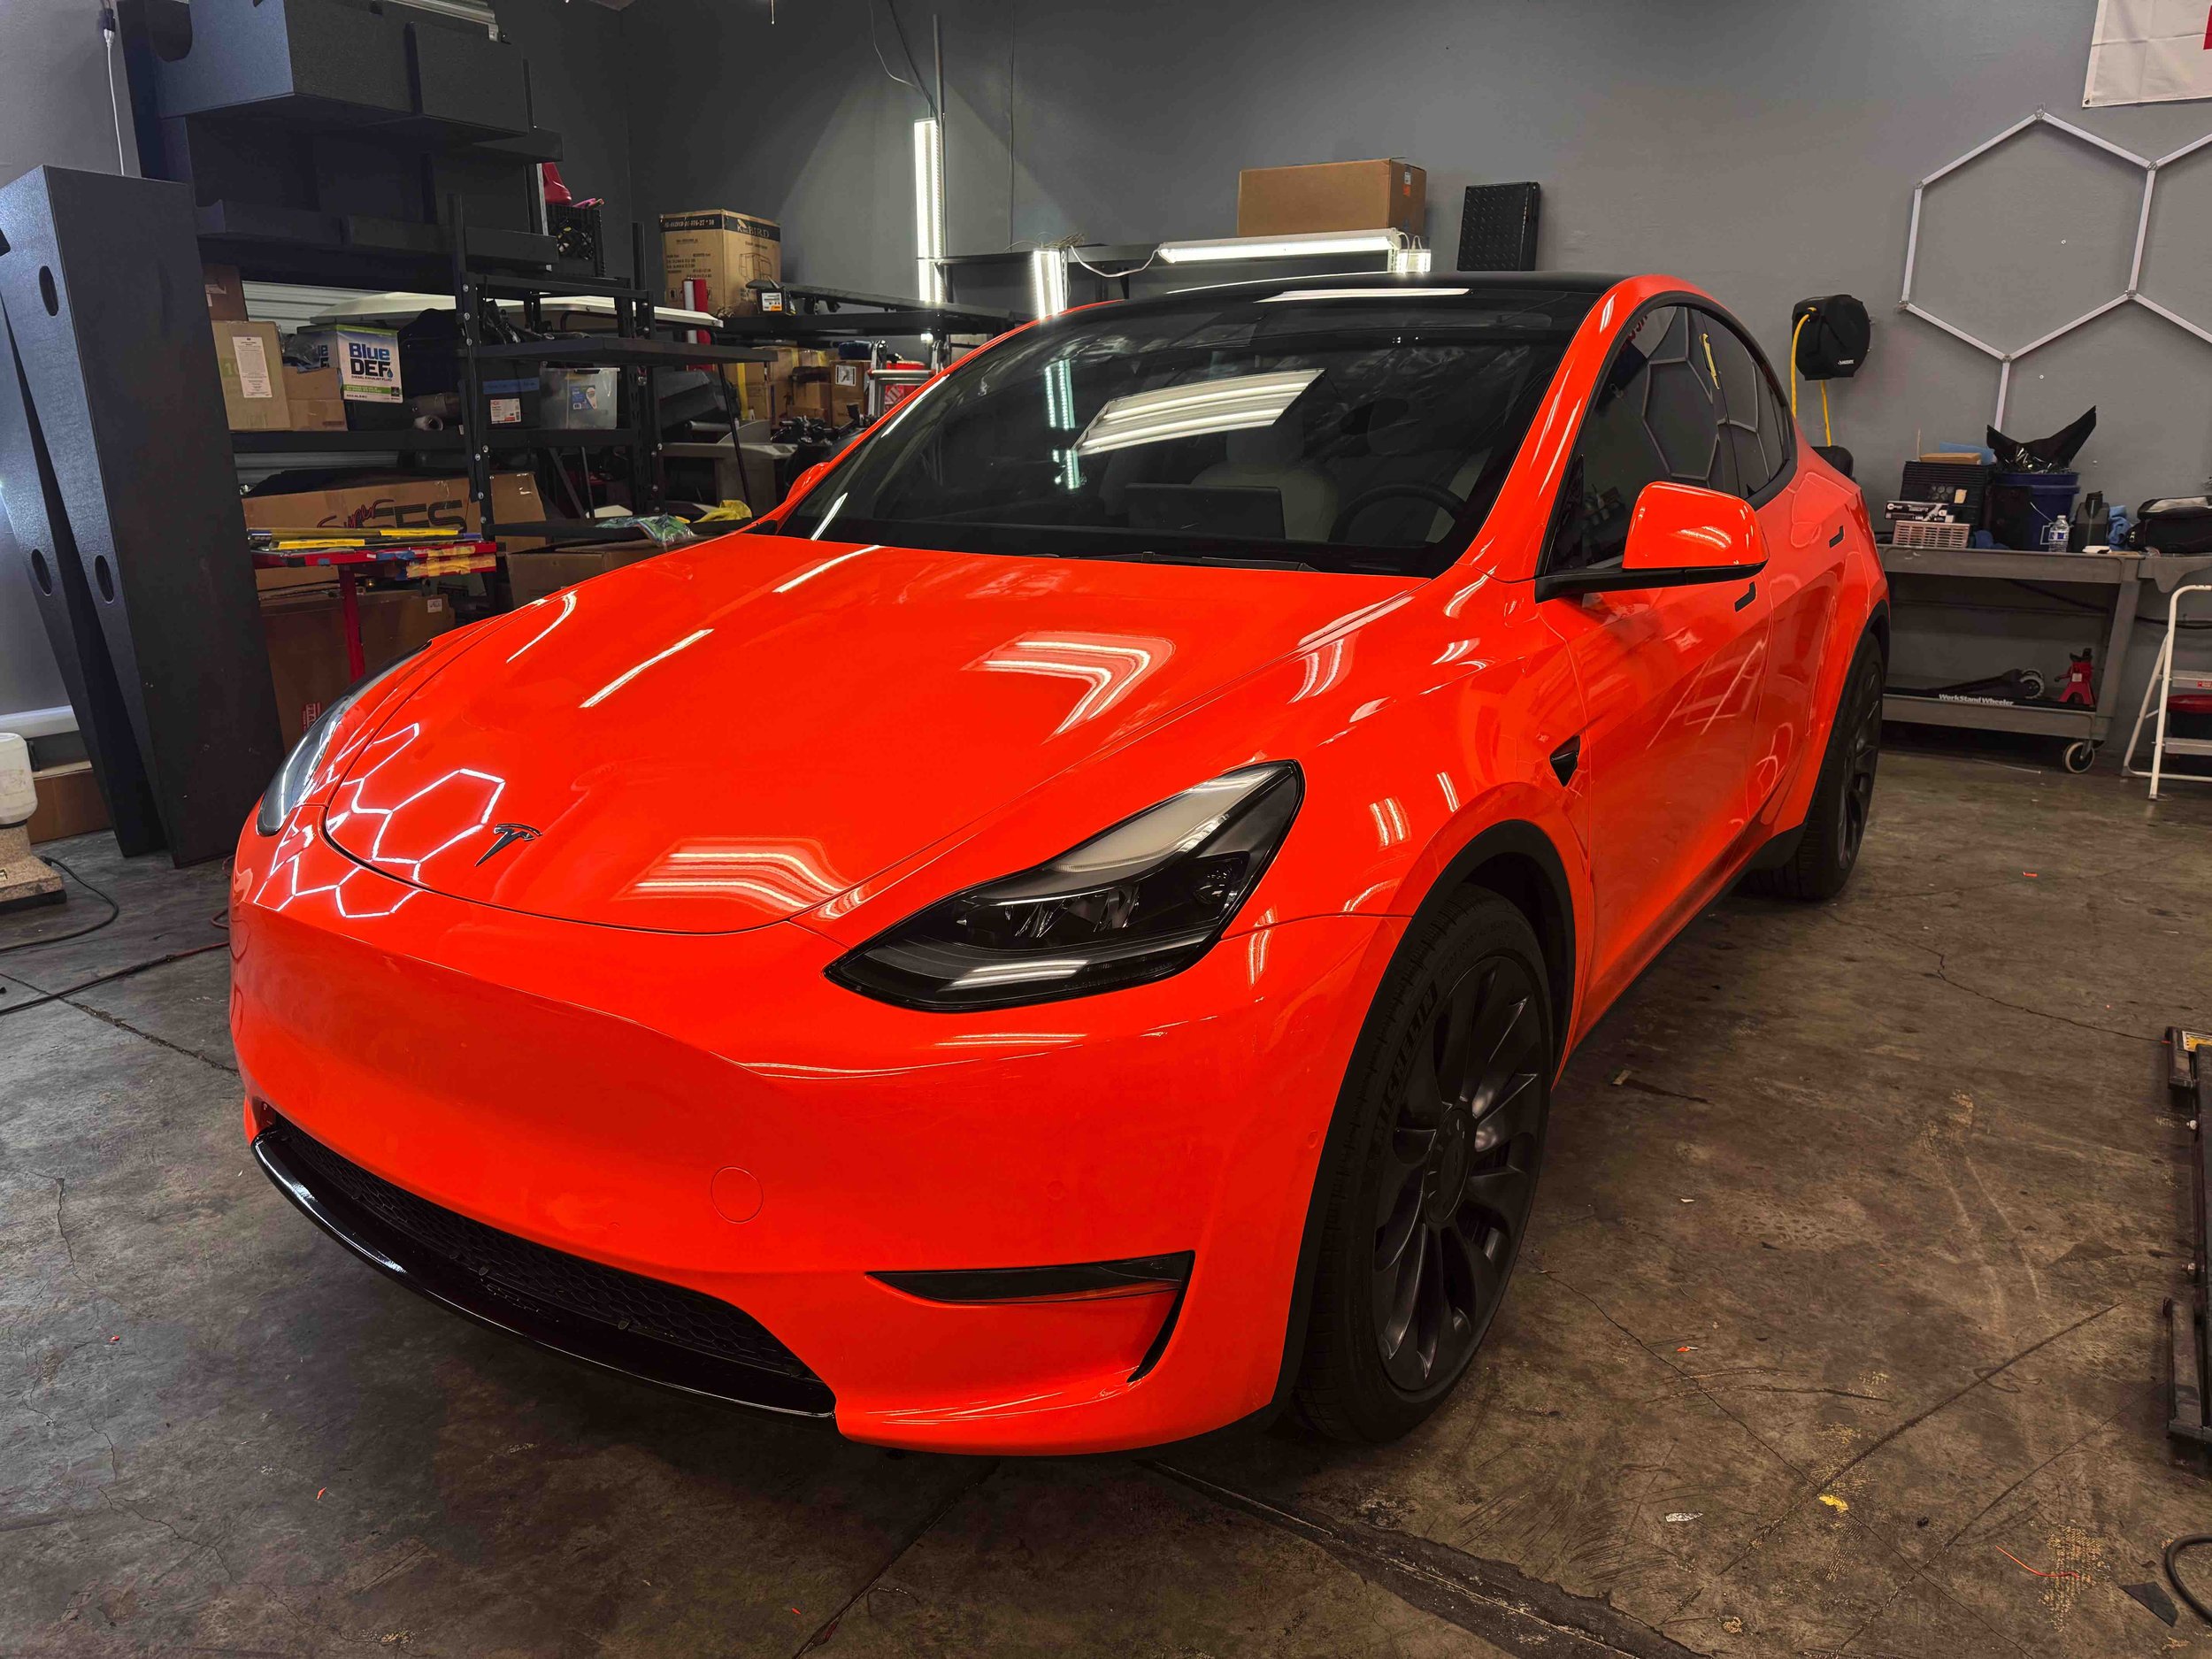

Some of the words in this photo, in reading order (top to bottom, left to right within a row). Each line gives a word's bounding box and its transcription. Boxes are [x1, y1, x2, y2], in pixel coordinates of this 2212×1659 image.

[349, 342, 390, 361] Blue
[349, 358, 390, 377] DEF
[1982, 697, 2014, 707] Wheeler
[1373, 979, 1439, 1139] MICHELIN
